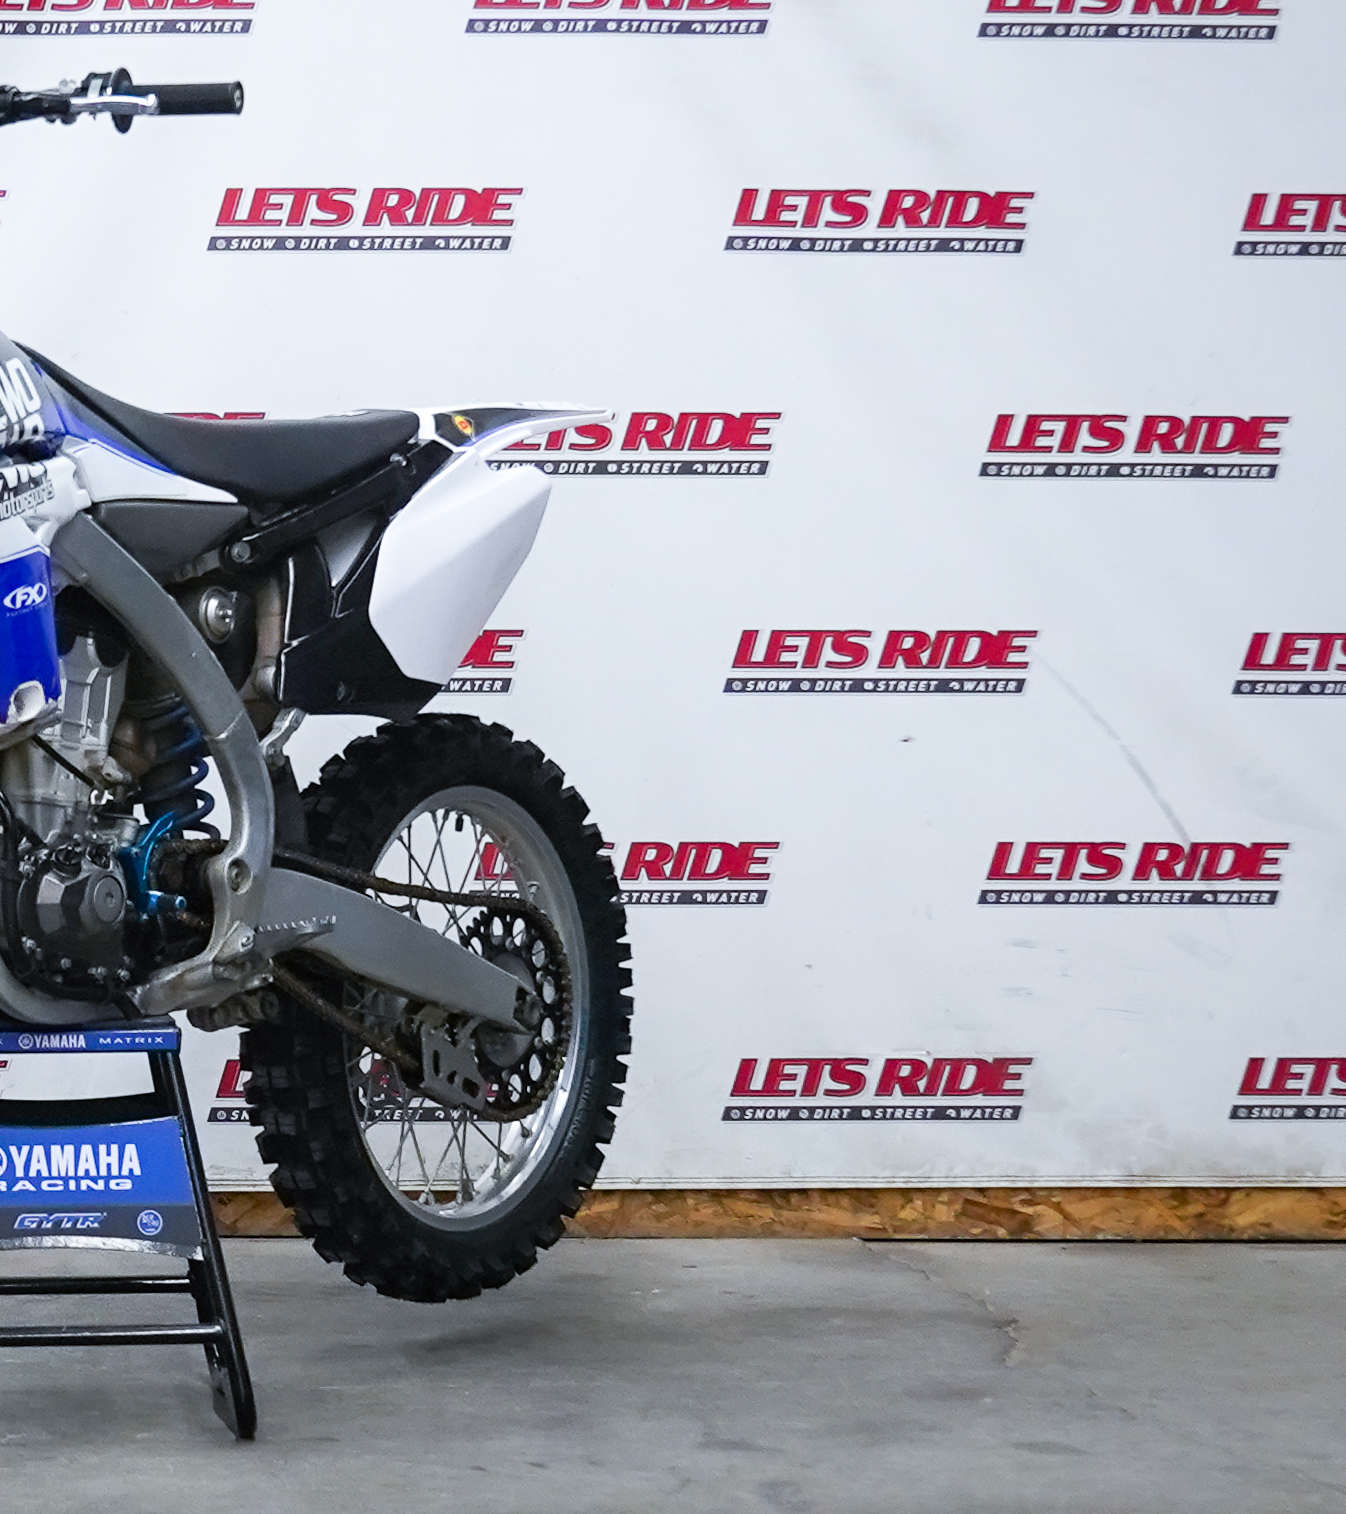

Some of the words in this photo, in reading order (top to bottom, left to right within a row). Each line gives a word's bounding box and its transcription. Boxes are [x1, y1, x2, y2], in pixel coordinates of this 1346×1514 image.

[41, 23, 79, 33] DIRT
[103, 21, 164, 33] STREET
[190, 21, 243, 32] WATER
[487, 21, 535, 31] SNOW
[557, 20, 596, 31] DIRT
[620, 21, 680, 32] STREET
[705, 22, 758, 33] WATER
[1000, 25, 1047, 36] SNOW
[1070, 26, 1107, 36] DIRT
[1131, 26, 1190, 37] STREET
[1215, 28, 1269, 38] WATER
[215, 187, 358, 227] LETS
[362, 187, 523, 226] RIDE
[733, 188, 872, 228] LETS
[877, 189, 1036, 229] RIDE
[230, 238, 276, 249] SNOW
[300, 238, 338, 249] DIRT
[362, 238, 424, 249] STREET
[448, 238, 502, 249] WATER
[747, 238, 792, 249] SNOW
[814, 240, 852, 250] DIRT
[876, 240, 939, 251] STREET
[964, 241, 1016, 251] WATER
[620, 412, 782, 451] RIDE
[986, 414, 1129, 454] LETS
[1134, 415, 1289, 455] RIDE
[558, 463, 596, 473] DIRT
[620, 463, 682, 473] STREET
[706, 463, 759, 473] WATER
[1000, 465, 1048, 475] SNOW
[1070, 465, 1109, 475] DIRT
[1133, 466, 1193, 476] STREET
[1217, 467, 1270, 477] WATER
[731, 629, 873, 669] LETS
[877, 630, 1039, 669] RIDE
[1242, 632, 1346, 672] LET
[449, 681, 502, 691] WATER
[746, 681, 792, 691] SNOW
[815, 681, 853, 690] DIRT
[876, 681, 938, 691] STREET
[963, 681, 1017, 691] WATER
[620, 841, 780, 881] RIDE
[986, 841, 1127, 881] LETS
[1131, 842, 1290, 881] RIDE
[620, 893, 681, 903] STREET
[706, 893, 758, 903] WATER
[1000, 893, 1046, 902] SNOW
[1069, 893, 1107, 902] DIRT
[1130, 893, 1192, 902] STREET
[1216, 893, 1270, 903] WATER
[35, 1033, 86, 1049] YAMAHA
[98, 1036, 164, 1045] MATRIX
[729, 1057, 870, 1097] LETS
[875, 1057, 1033, 1097] RIDE
[1239, 1057, 1346, 1096] LET
[744, 1109, 790, 1119] SNOW
[814, 1109, 850, 1118] DIRT
[875, 1109, 935, 1118] STREET
[960, 1108, 1013, 1119] WATER
[9, 1144, 142, 1177] YAMAHA
